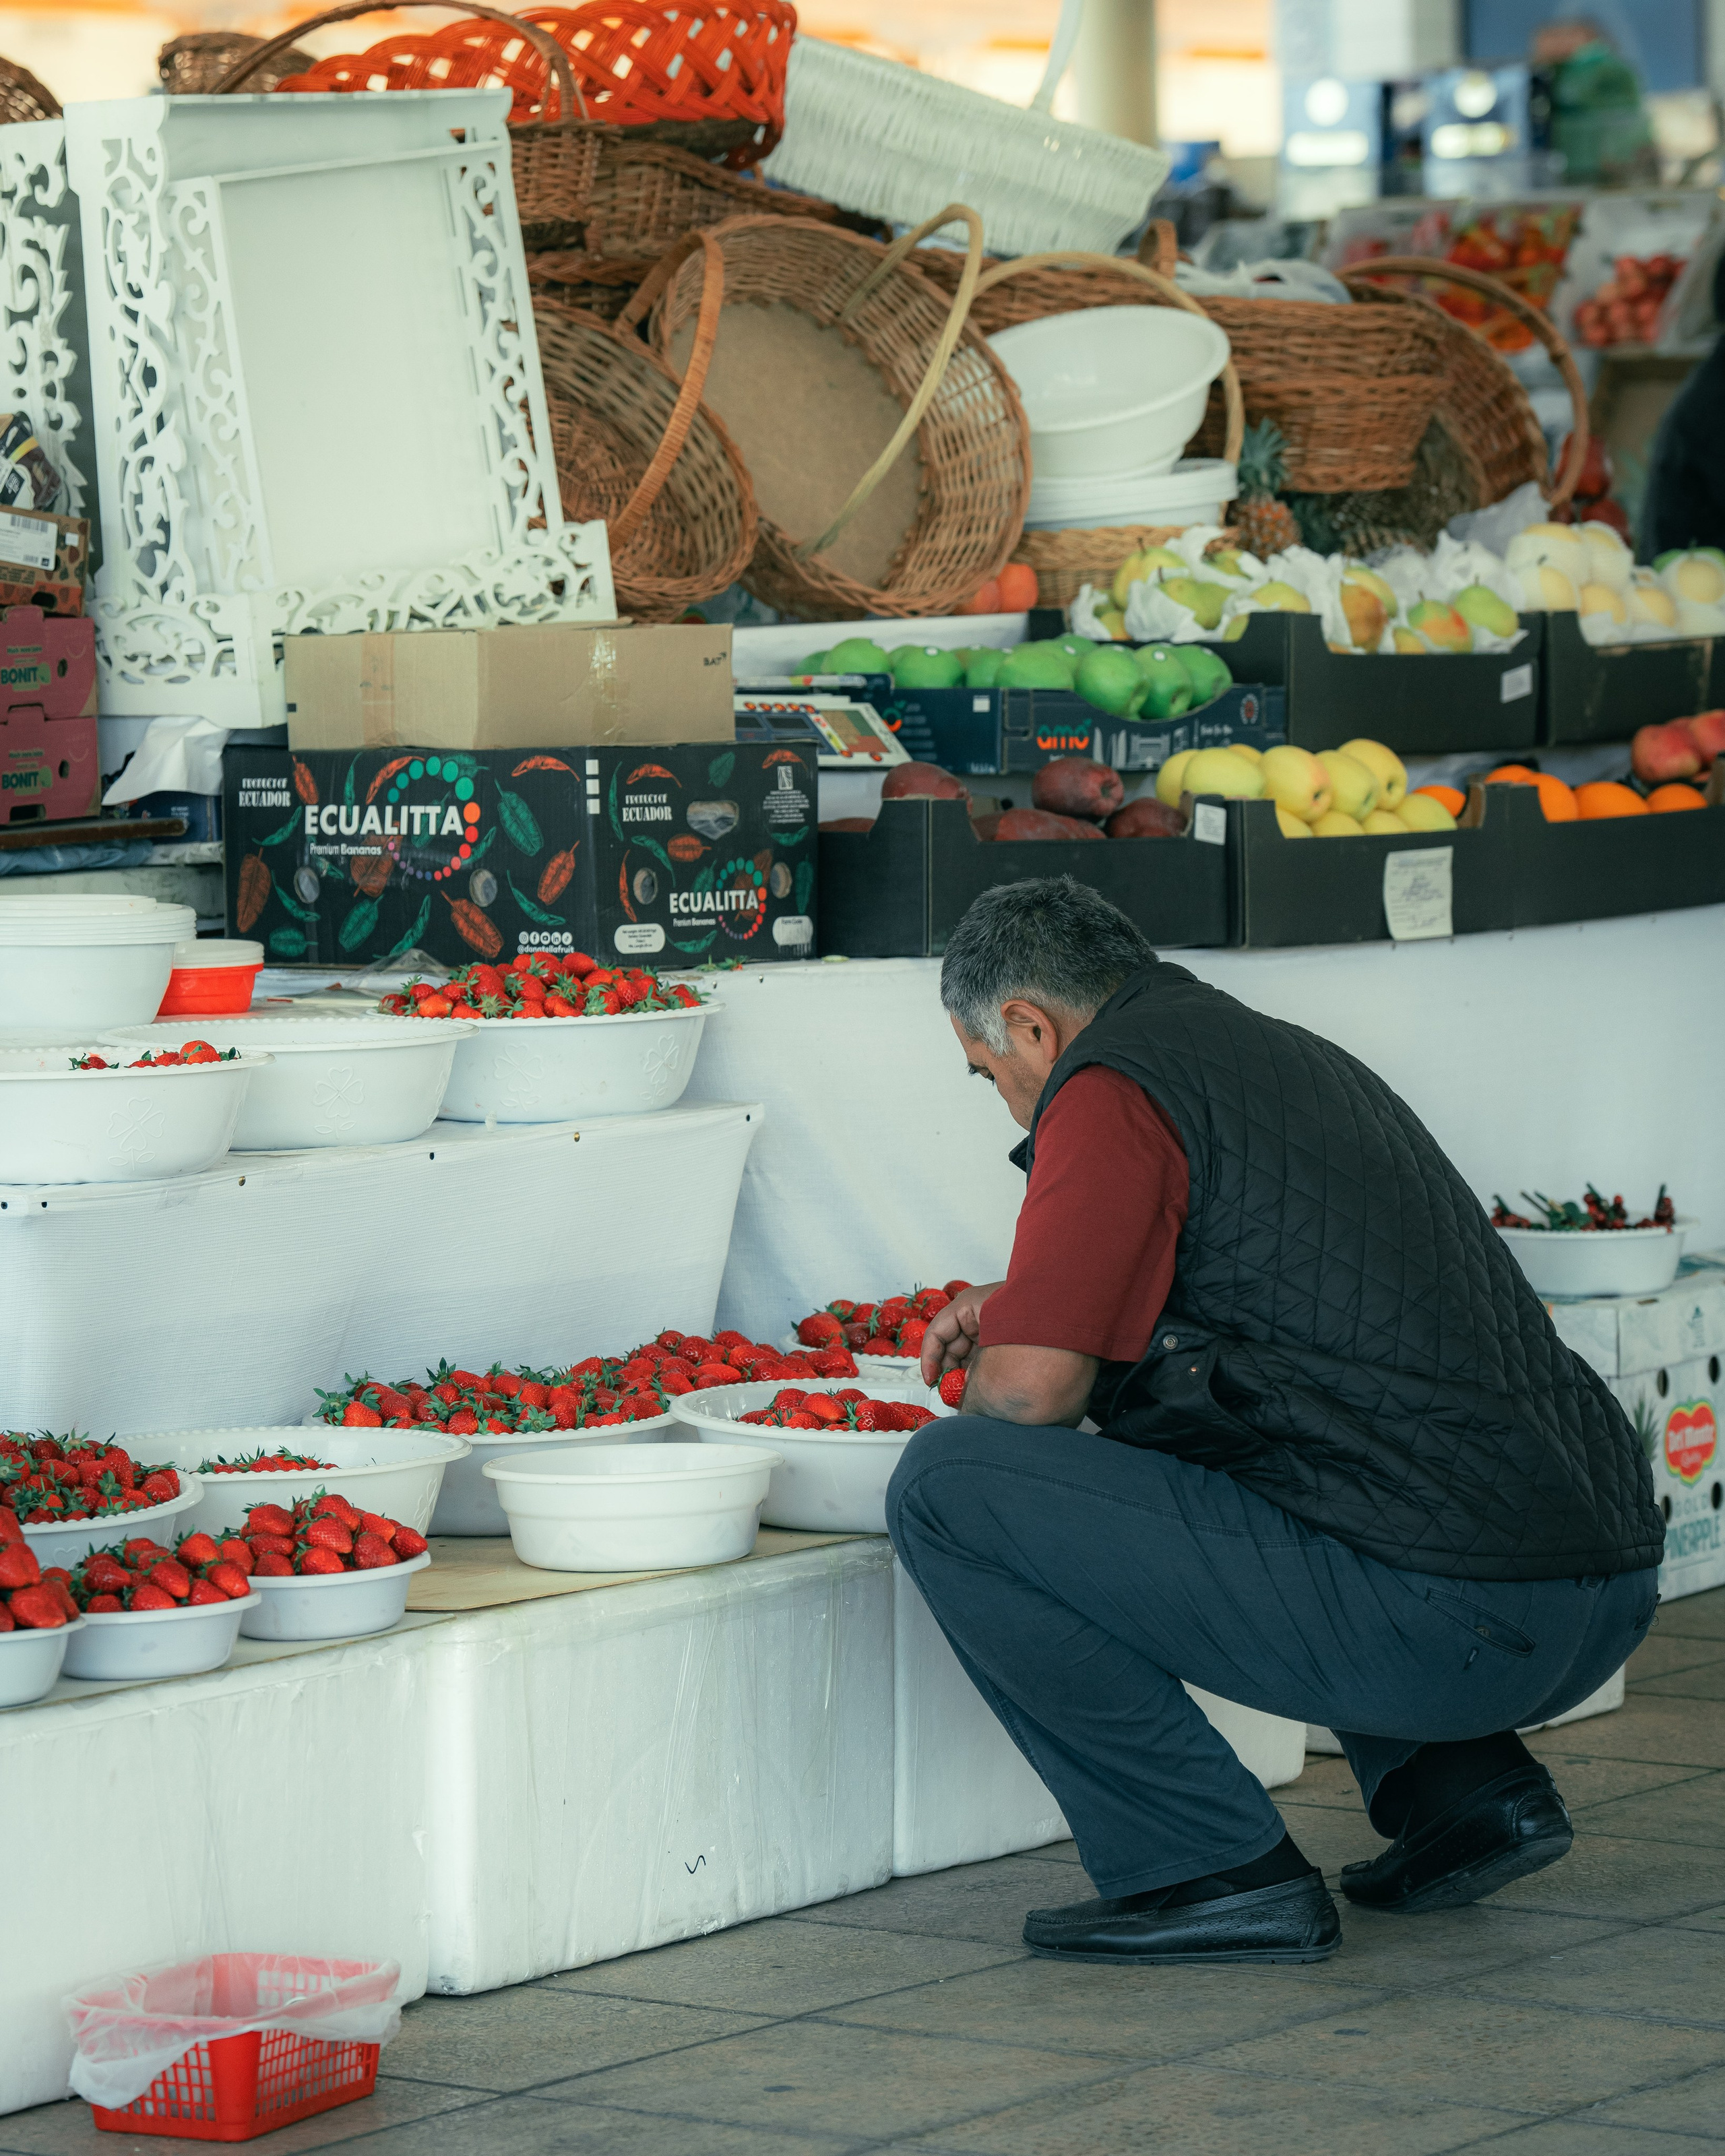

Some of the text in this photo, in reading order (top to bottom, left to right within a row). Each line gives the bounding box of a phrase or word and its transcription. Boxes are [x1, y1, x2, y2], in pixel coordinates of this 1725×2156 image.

[243, 778, 288, 789] PRODUCT OF
[239, 790, 291, 807] ECUADOR
[625, 793, 668, 804] PRODUCT OF
[305, 804, 464, 836] ECUALITTA
[622, 806, 672, 822] ECUADOR
[310, 843, 382, 855] Premium Bananas
[669, 889, 759, 914] ECUALITTA
[673, 918, 716, 927] Premium Bananas
